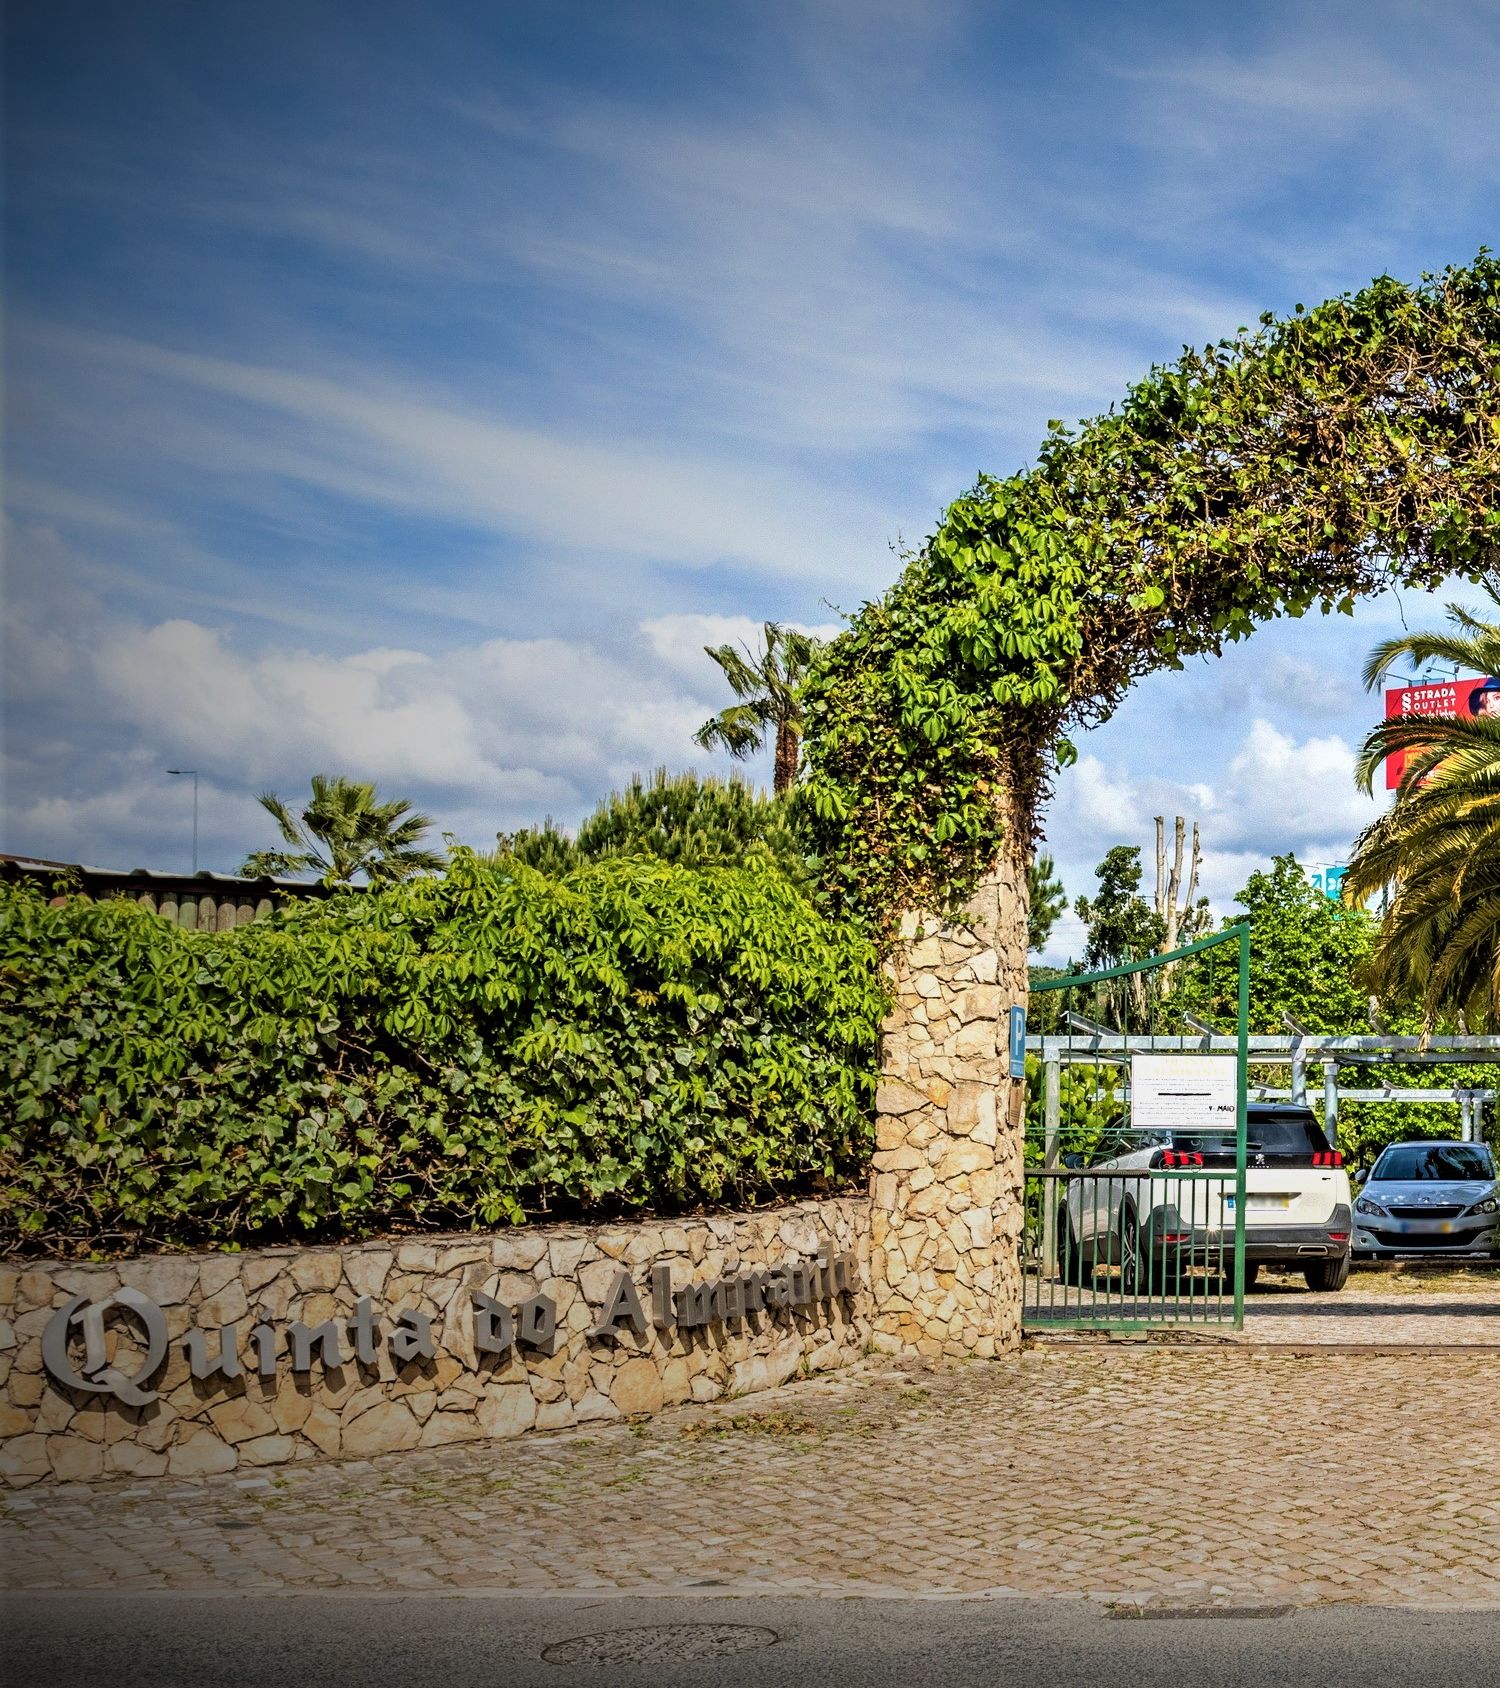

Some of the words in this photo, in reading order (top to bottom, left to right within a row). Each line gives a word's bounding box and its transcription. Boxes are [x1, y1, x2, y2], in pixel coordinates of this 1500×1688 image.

[1413, 698, 1456, 710] OUTLET
[1414, 687, 1456, 700] STRADA
[1015, 1011, 1023, 1056] P
[41, 1286, 438, 1406] Quinta
[472, 1290, 557, 1354] do
[585, 1240, 860, 1337] Almirante
